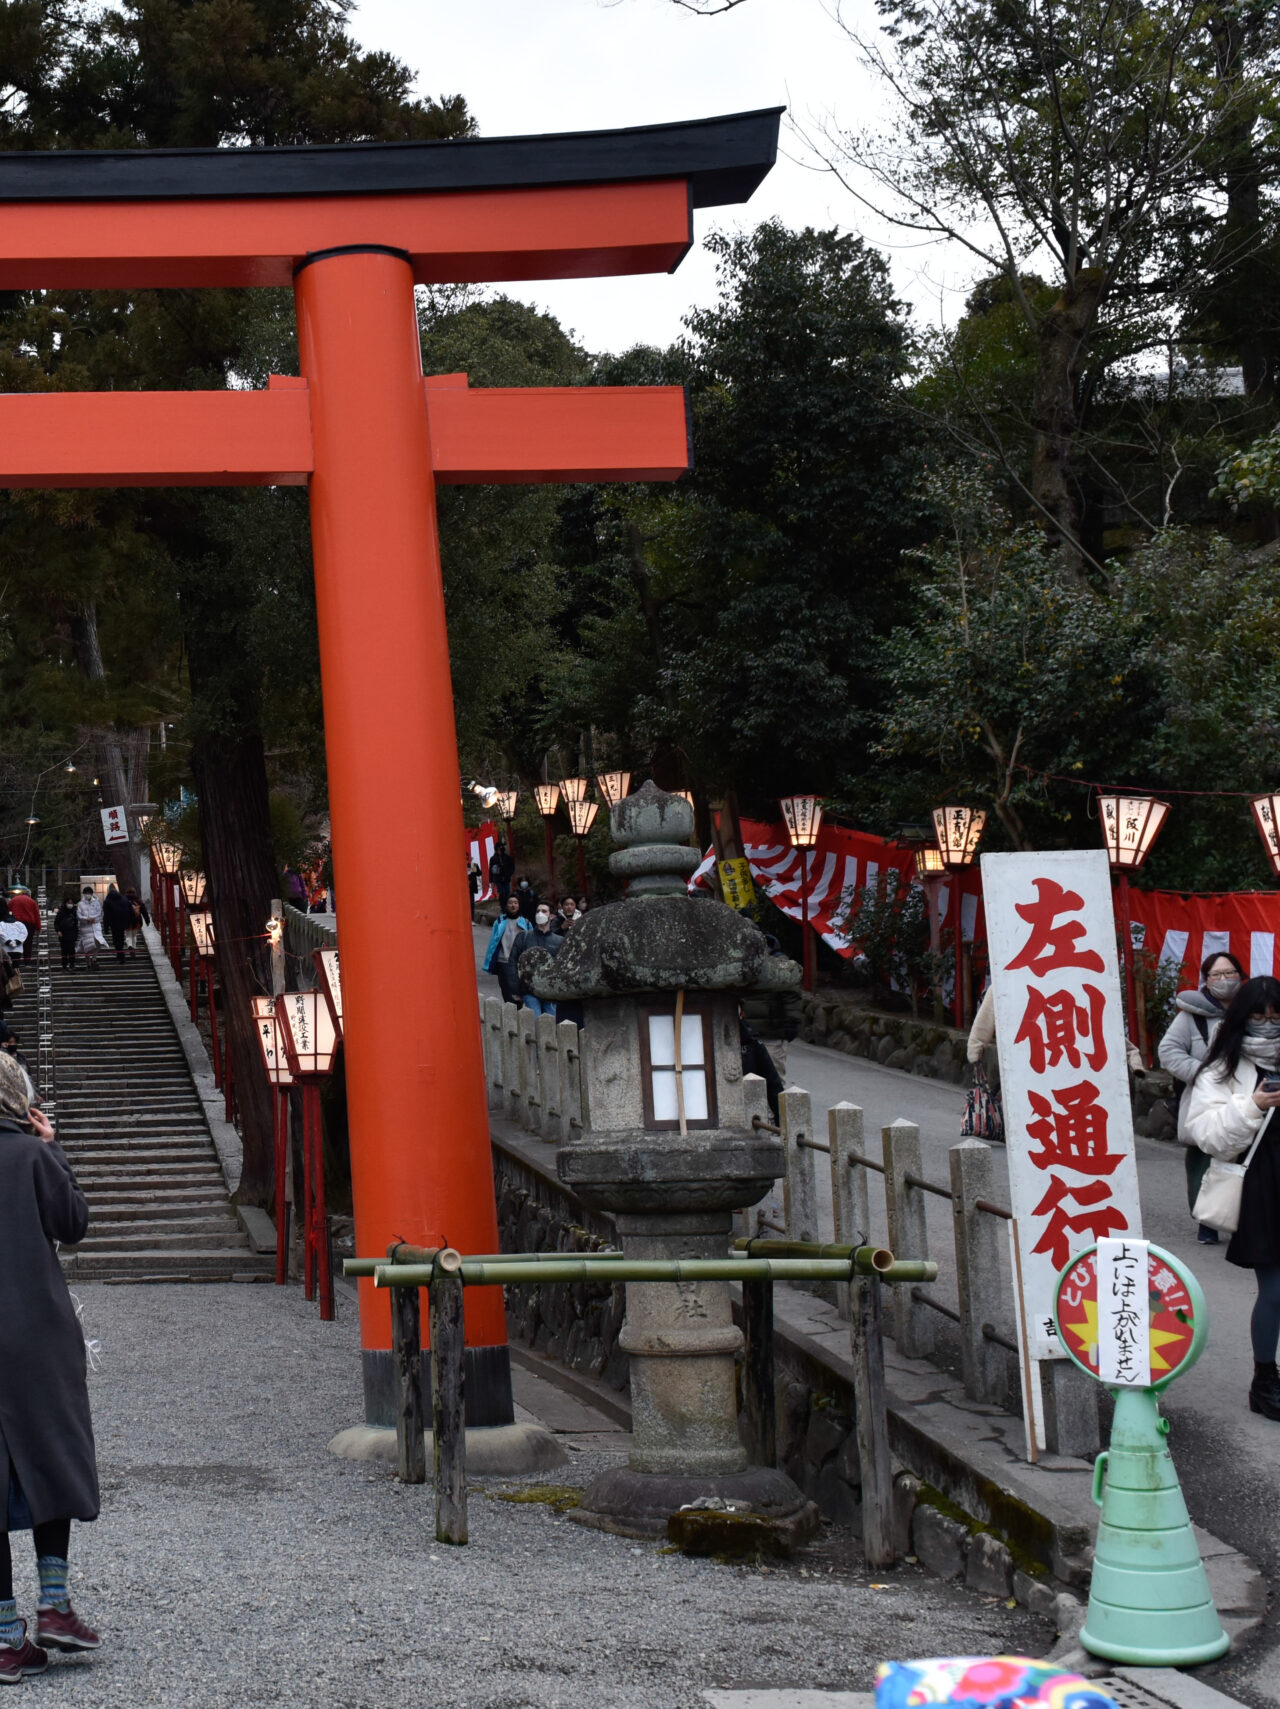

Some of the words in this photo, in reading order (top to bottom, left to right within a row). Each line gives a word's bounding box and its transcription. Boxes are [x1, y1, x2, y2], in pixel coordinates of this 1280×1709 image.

[108, 809, 121, 832] 順路
[1003, 877, 1129, 1273] 左側通行
[1111, 1243, 1141, 1383] 上には上がれません
